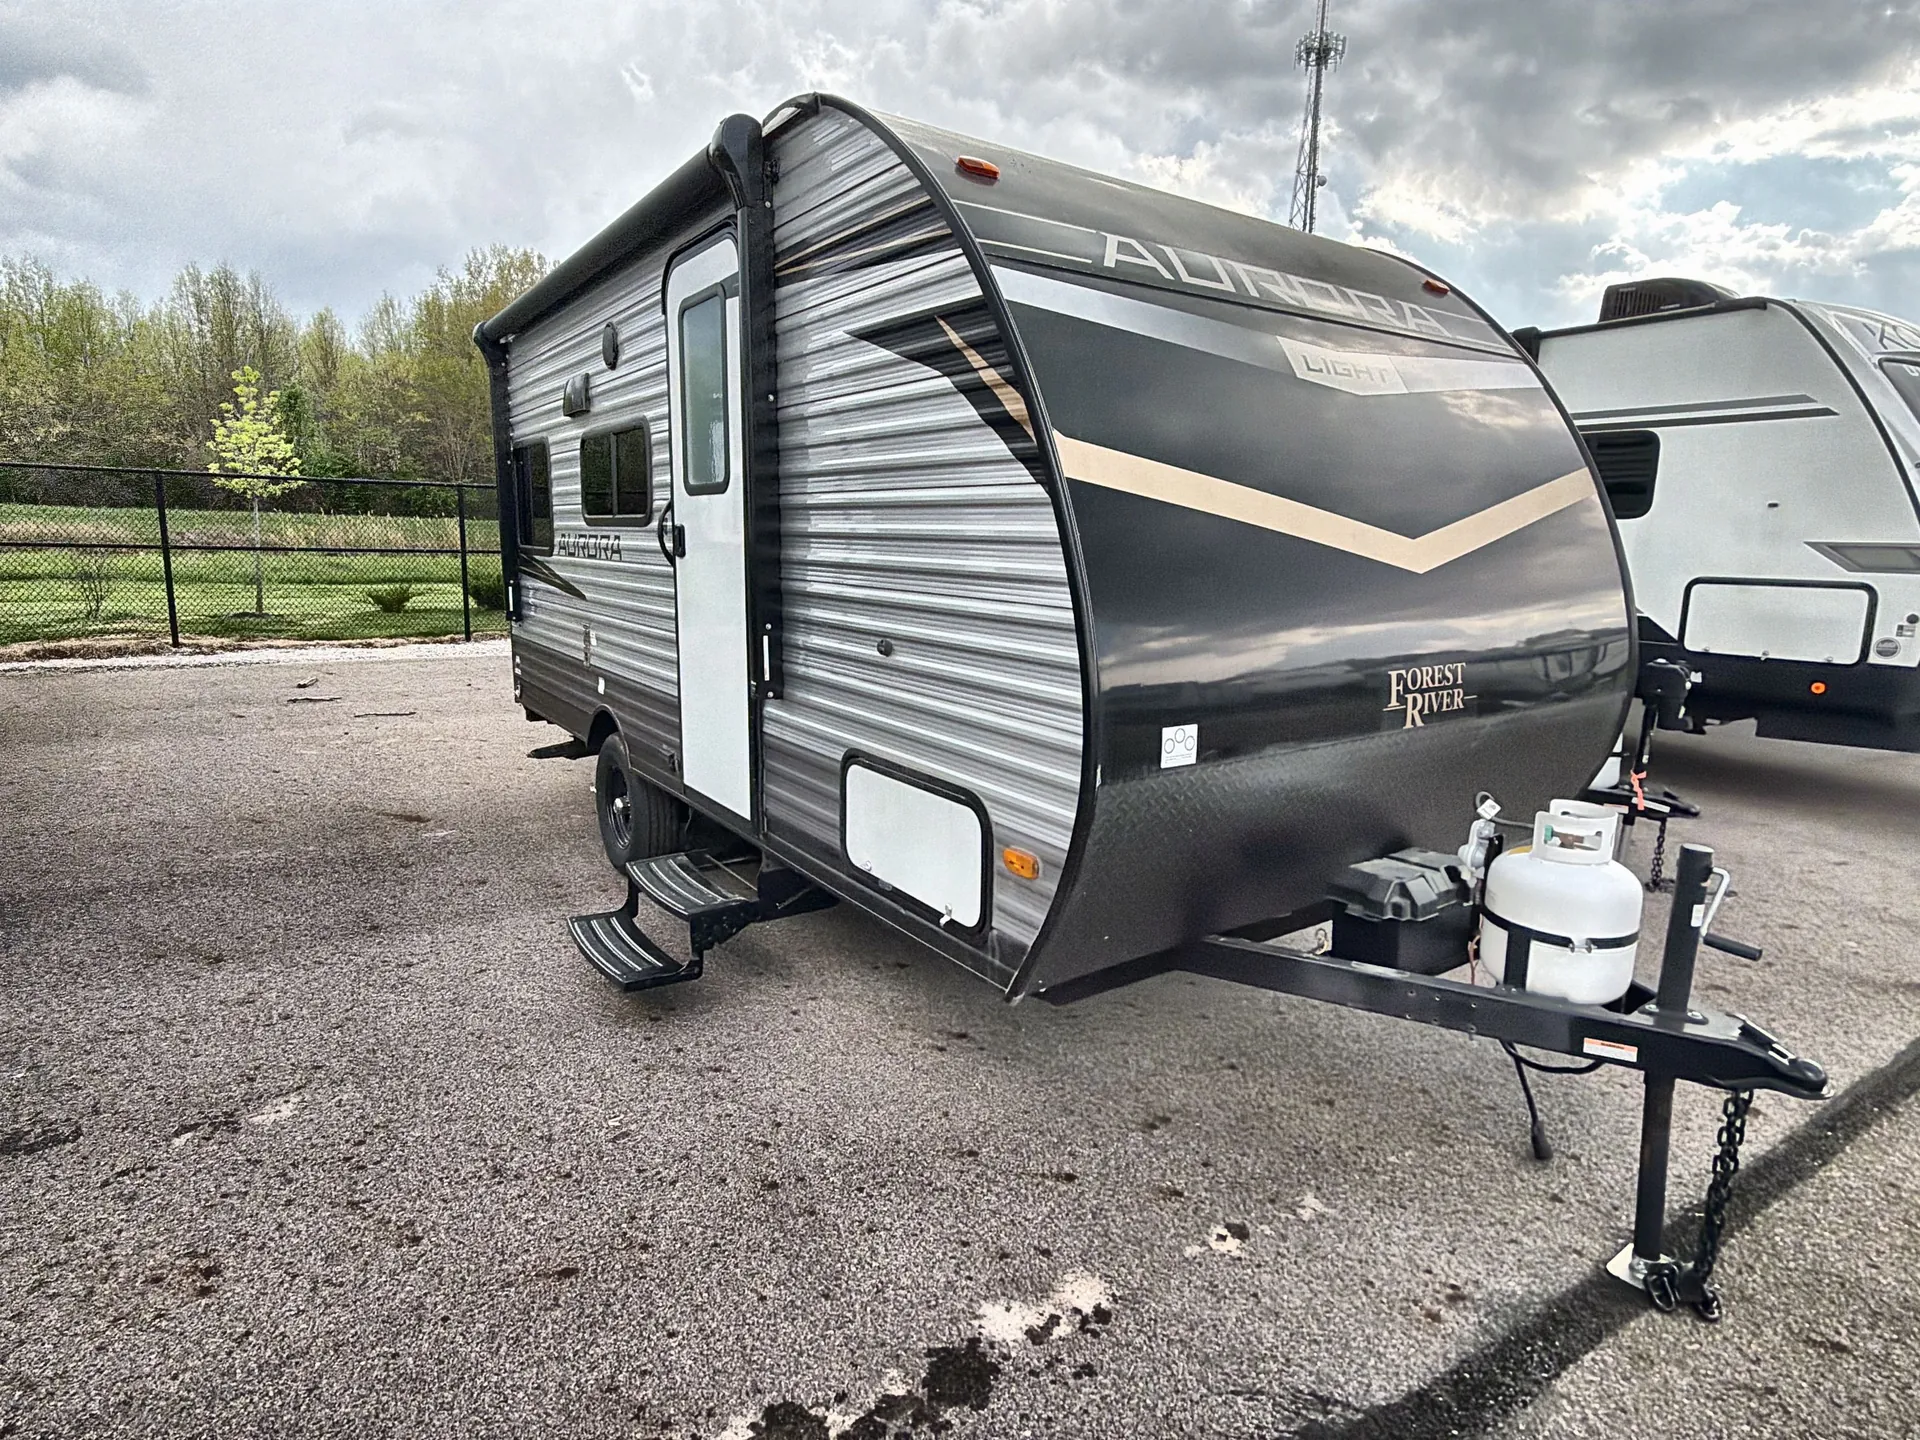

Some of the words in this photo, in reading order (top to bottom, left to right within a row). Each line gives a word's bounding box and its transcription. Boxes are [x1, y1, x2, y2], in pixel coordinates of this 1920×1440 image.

[1101, 232, 1450, 337] AURORA
[1301, 354, 1389, 384] LIGHT
[557, 533, 622, 561] AURORA
[1387, 662, 1467, 707] FOREST
[1402, 688, 1465, 729] RIVER
